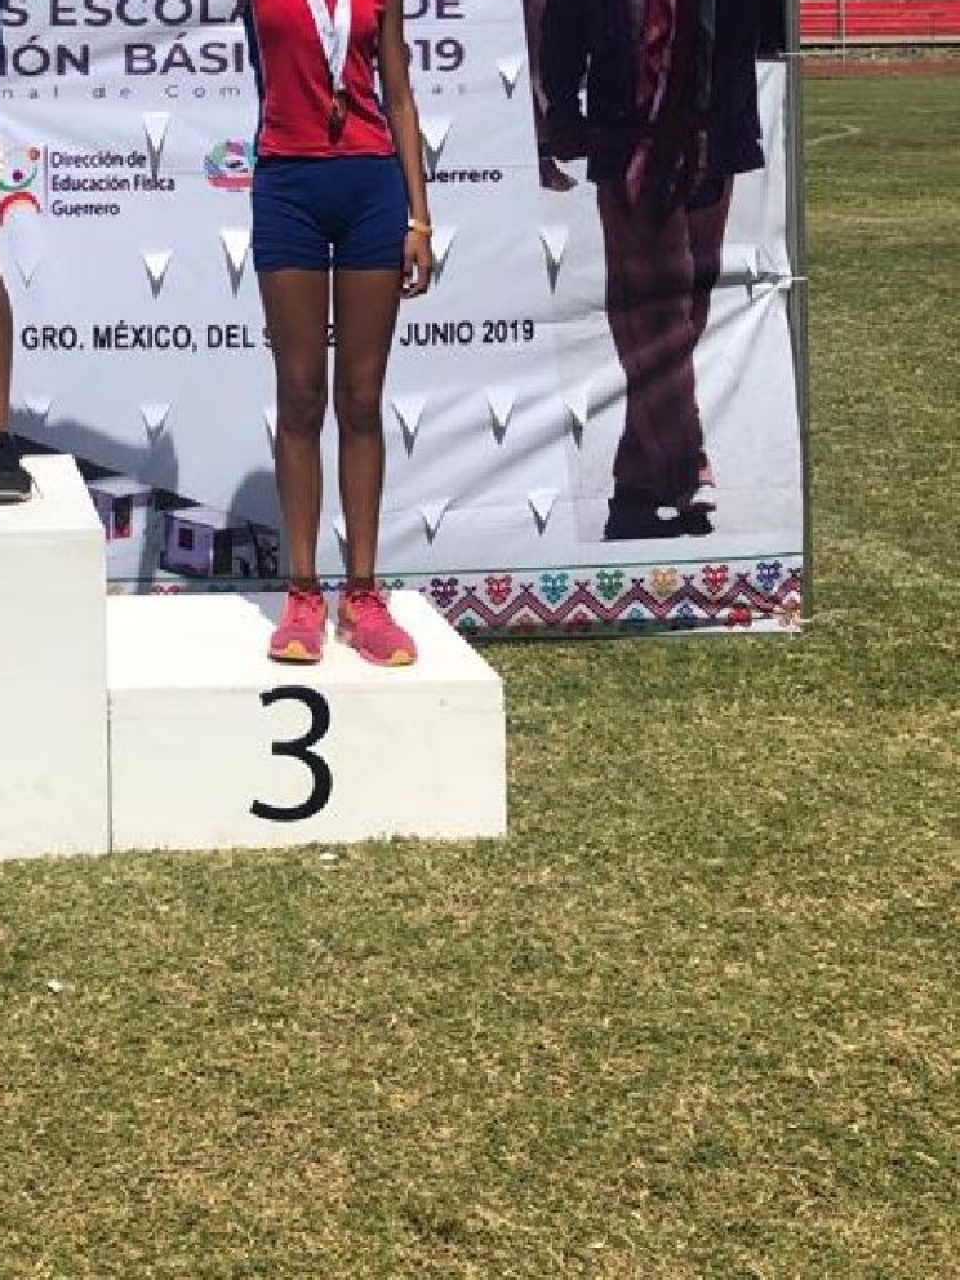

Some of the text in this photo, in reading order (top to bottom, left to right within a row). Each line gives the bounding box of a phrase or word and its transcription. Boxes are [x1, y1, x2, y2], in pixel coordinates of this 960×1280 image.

[50, 150, 147, 169] Dirección de
[51, 173, 131, 192] Educación
[51, 199, 121, 217] Guerrero
[21, 324, 85, 352] GRO.
[92, 319, 198, 354] MÉXICO,
[207, 324, 255, 349] DEL
[399, 322, 474, 347] JUNIO
[482, 320, 534, 344] 2019
[250, 684, 333, 822] 3
